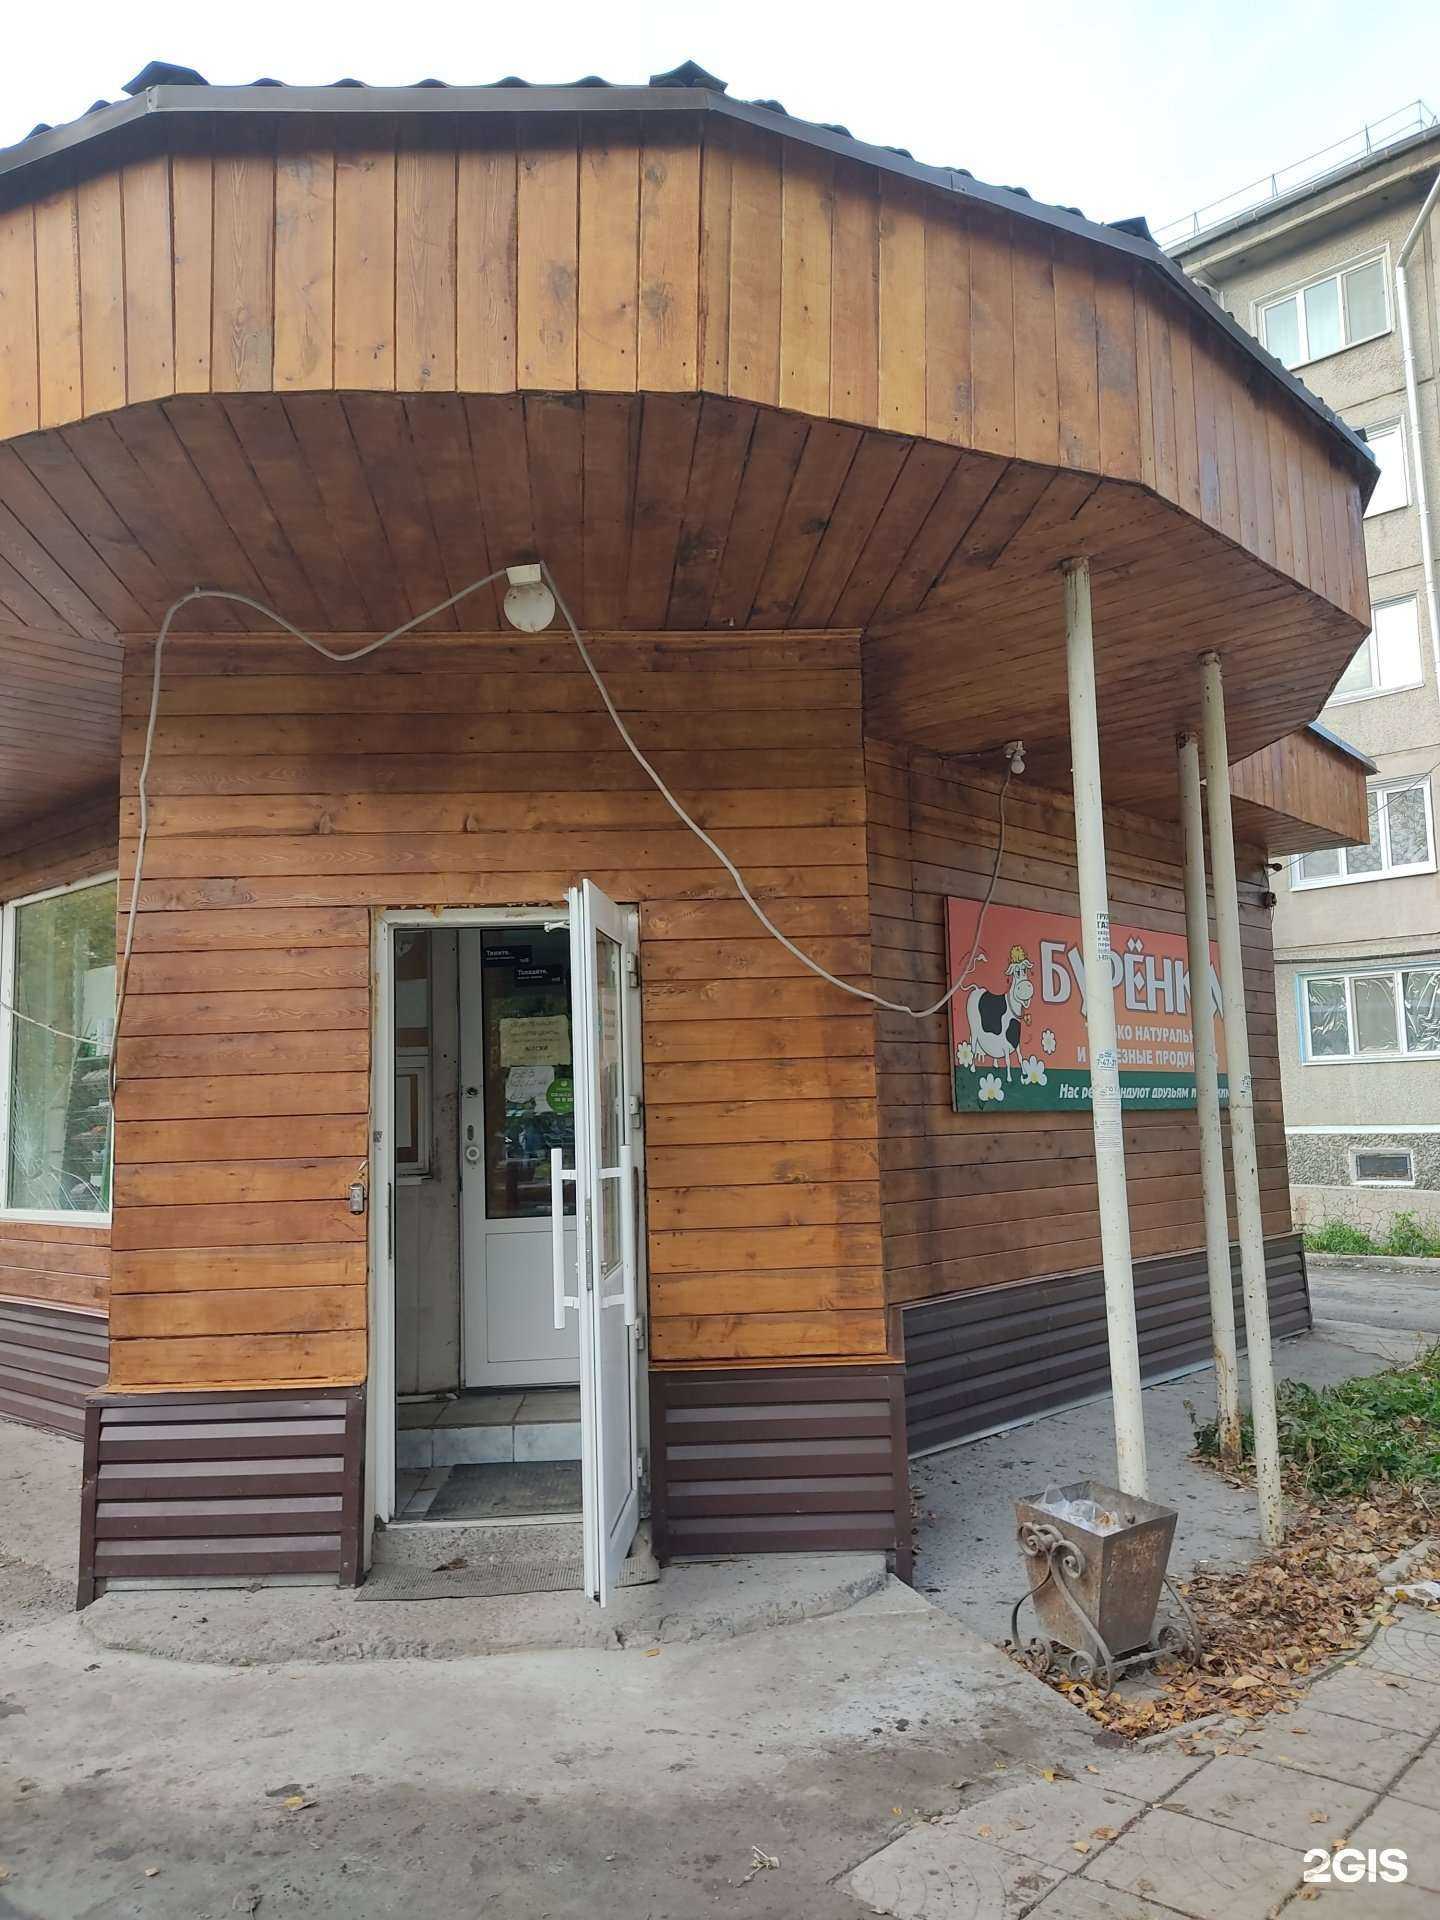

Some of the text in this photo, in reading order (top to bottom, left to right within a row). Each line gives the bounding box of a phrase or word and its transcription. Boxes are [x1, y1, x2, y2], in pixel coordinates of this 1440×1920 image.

[1077, 1046, 1087, 1063] И
[1059, 1083, 1080, 1099] Нас
[1151, 1086, 1188, 1100] друзьям
